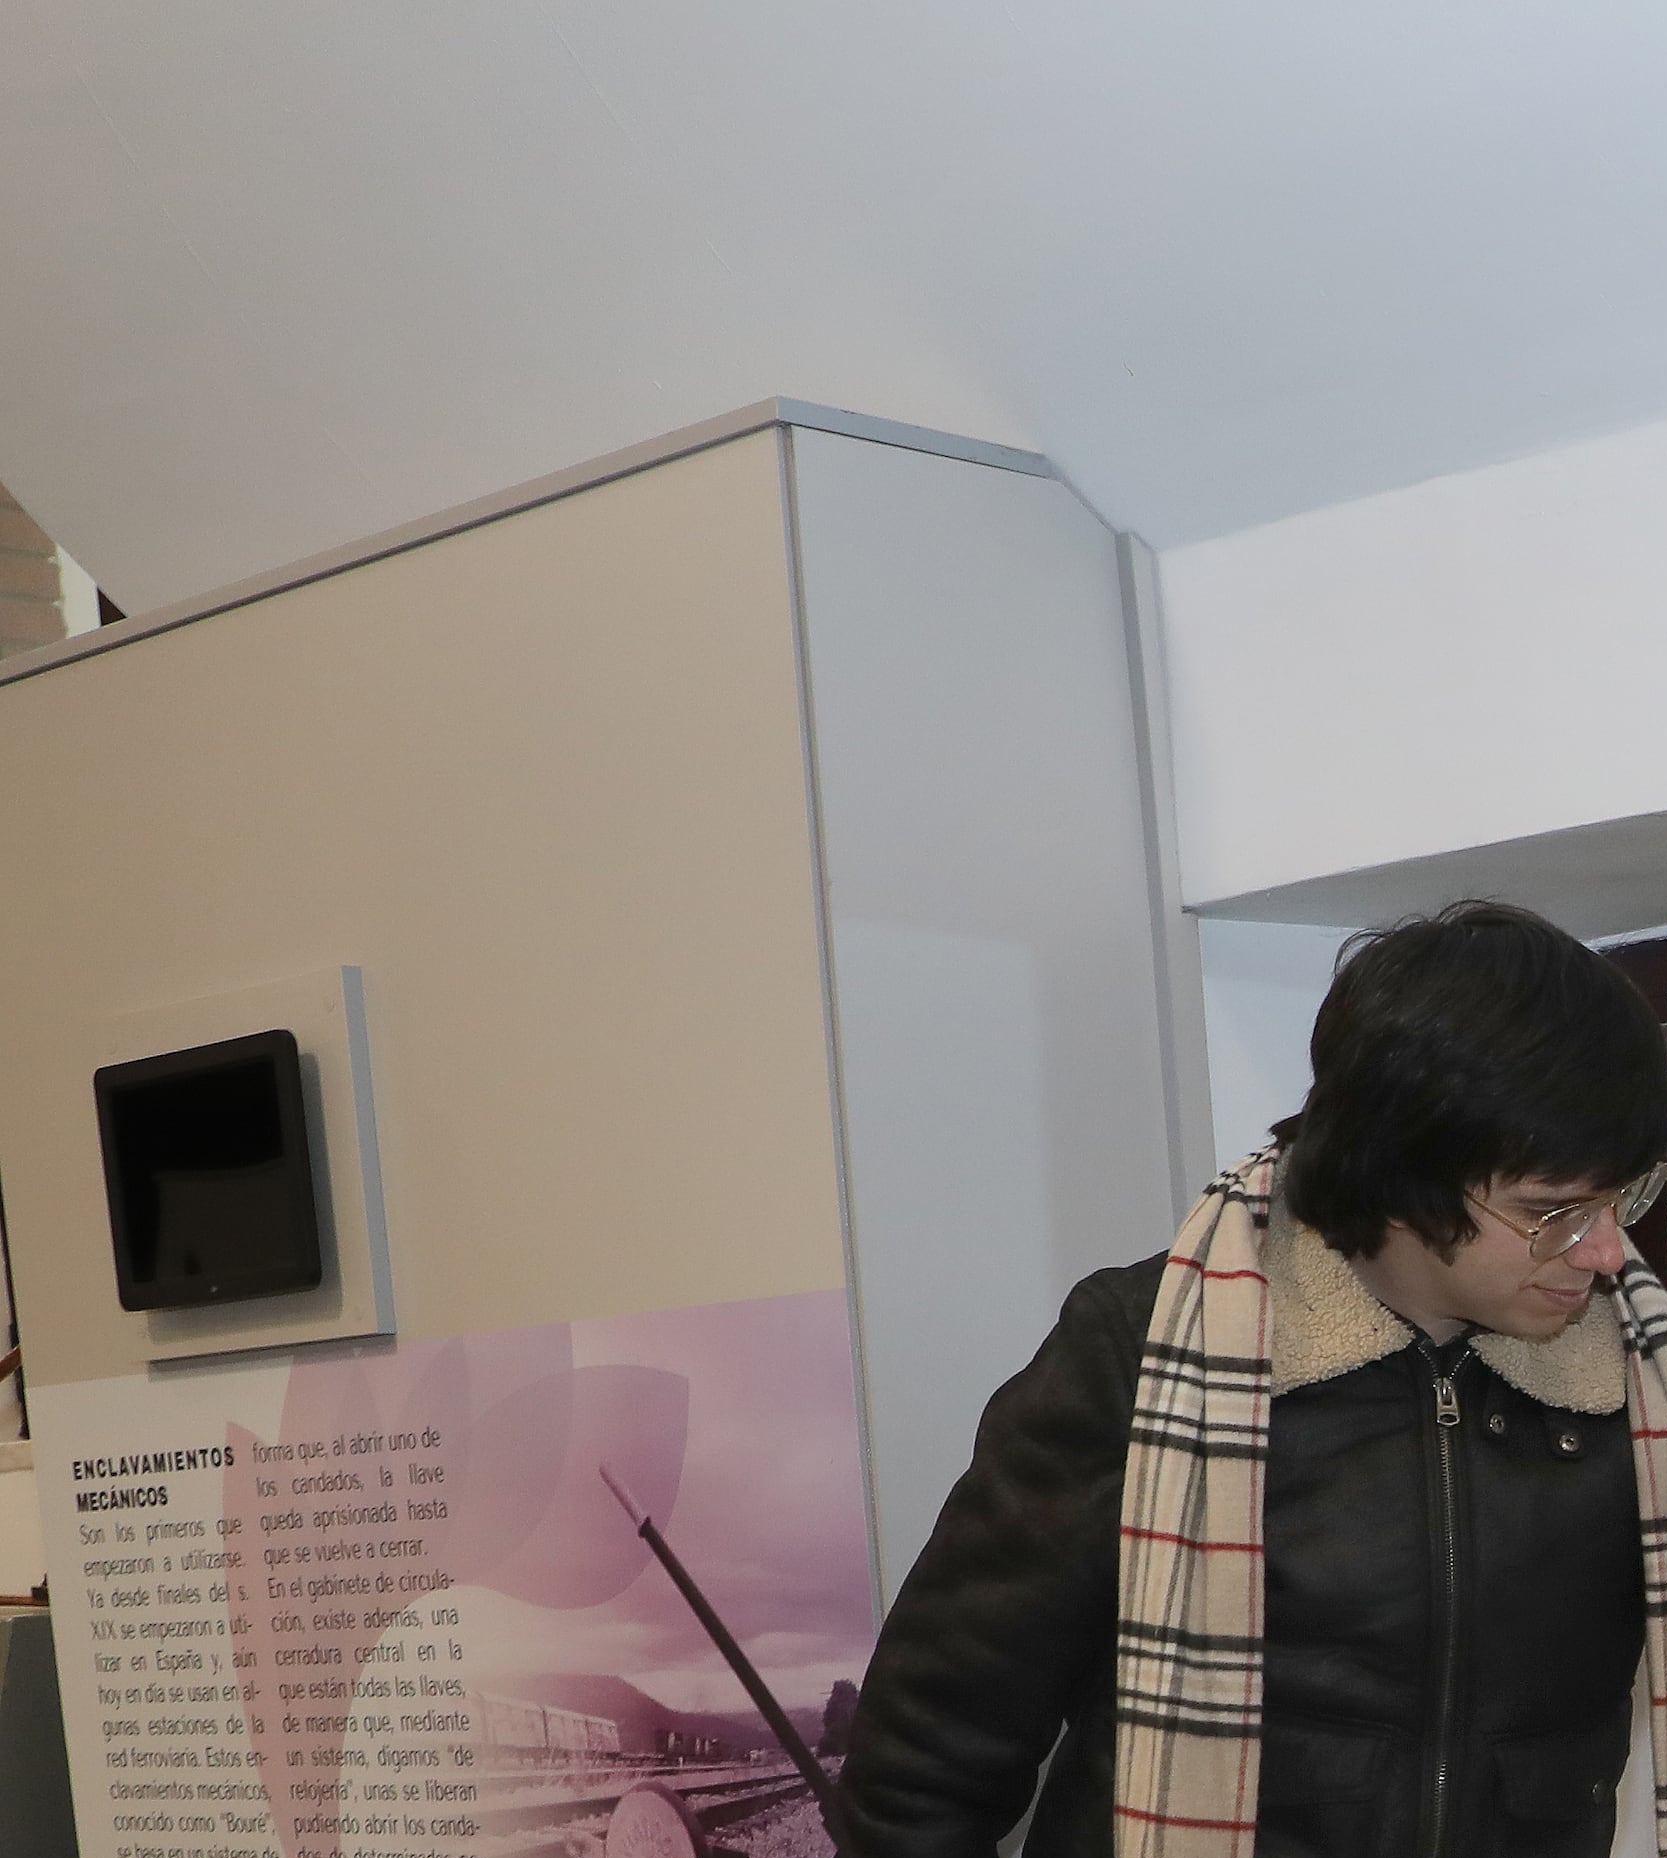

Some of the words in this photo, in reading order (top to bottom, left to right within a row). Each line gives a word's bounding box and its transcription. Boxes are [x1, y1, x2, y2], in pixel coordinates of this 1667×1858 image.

[253, 1442, 293, 1463] forma
[298, 1442, 328, 1466] que,
[333, 1435, 344, 1456] al
[350, 1431, 384, 1455] abrir
[389, 1432, 417, 1451] uno
[422, 1427, 441, 1448] de
[73, 1446, 234, 1481] ENCLAVAMIENTOS
[257, 1477, 278, 1498] los
[292, 1470, 364, 1495] candados,
[379, 1466, 393, 1487] la
[409, 1463, 444, 1485] llave
[77, 1486, 168, 1512] MECÁNICOS
[80, 1525, 105, 1545] Son
[116, 1523, 136, 1543] los
[146, 1520, 205, 1545] primeros
[216, 1518, 242, 1540] que
[260, 1508, 303, 1537] queda
[313, 1501, 397, 1533] aprisionada
[407, 1499, 448, 1521] hasta
[264, 1548, 290, 1570] que
[295, 1548, 310, 1562] se
[316, 1539, 361, 1561] vuelve
[366, 1542, 375, 1558] a
[380, 1539, 428, 1557] cerrar.
[84, 1558, 153, 1581] empezaron
[164, 1556, 171, 1572] a
[88, 1588, 104, 1608] Ya
[112, 1587, 150, 1607] desde
[158, 1585, 200, 1604] finales
[209, 1583, 230, 1602] del
[268, 1577, 286, 1599] En
[290, 1577, 302, 1597] el
[308, 1574, 370, 1603] gabinete
[375, 1572, 394, 1593] de
[399, 1569, 454, 1592] circula-
[272, 1611, 305, 1633] ción,
[313, 1609, 355, 1631] existe
[364, 1606, 423, 1629] además,
[431, 1608, 459, 1626] una
[275, 1643, 342, 1666] cerradura
[354, 1641, 404, 1664] central
[418, 1644, 435, 1661] en
[449, 1639, 463, 1660] la
[279, 1684, 304, 1706] que
[309, 1677, 346, 1698] están
[351, 1677, 391, 1698] todas
[395, 1676, 416, 1697] las
[419, 1675, 466, 1699] llaves,
[283, 1713, 299, 1733] de
[306, 1715, 357, 1733] manera
[364, 1718, 394, 1738] que,
[401, 1710, 470, 1731] mediante
[287, 1750, 303, 1766] un
[312, 1746, 369, 1770] sistema,
[378, 1746, 439, 1773] digamos
[110, 1780, 193, 1800] clavamientos
[364, 1785, 397, 1801] unas
[403, 1785, 419, 1801] se
[425, 1779, 477, 1801] liberan
[294, 1815, 359, 1840] pudiendo
[365, 1814, 399, 1834] abrir
[403, 1815, 425, 1835] los
[431, 1815, 480, 1837] canda-
